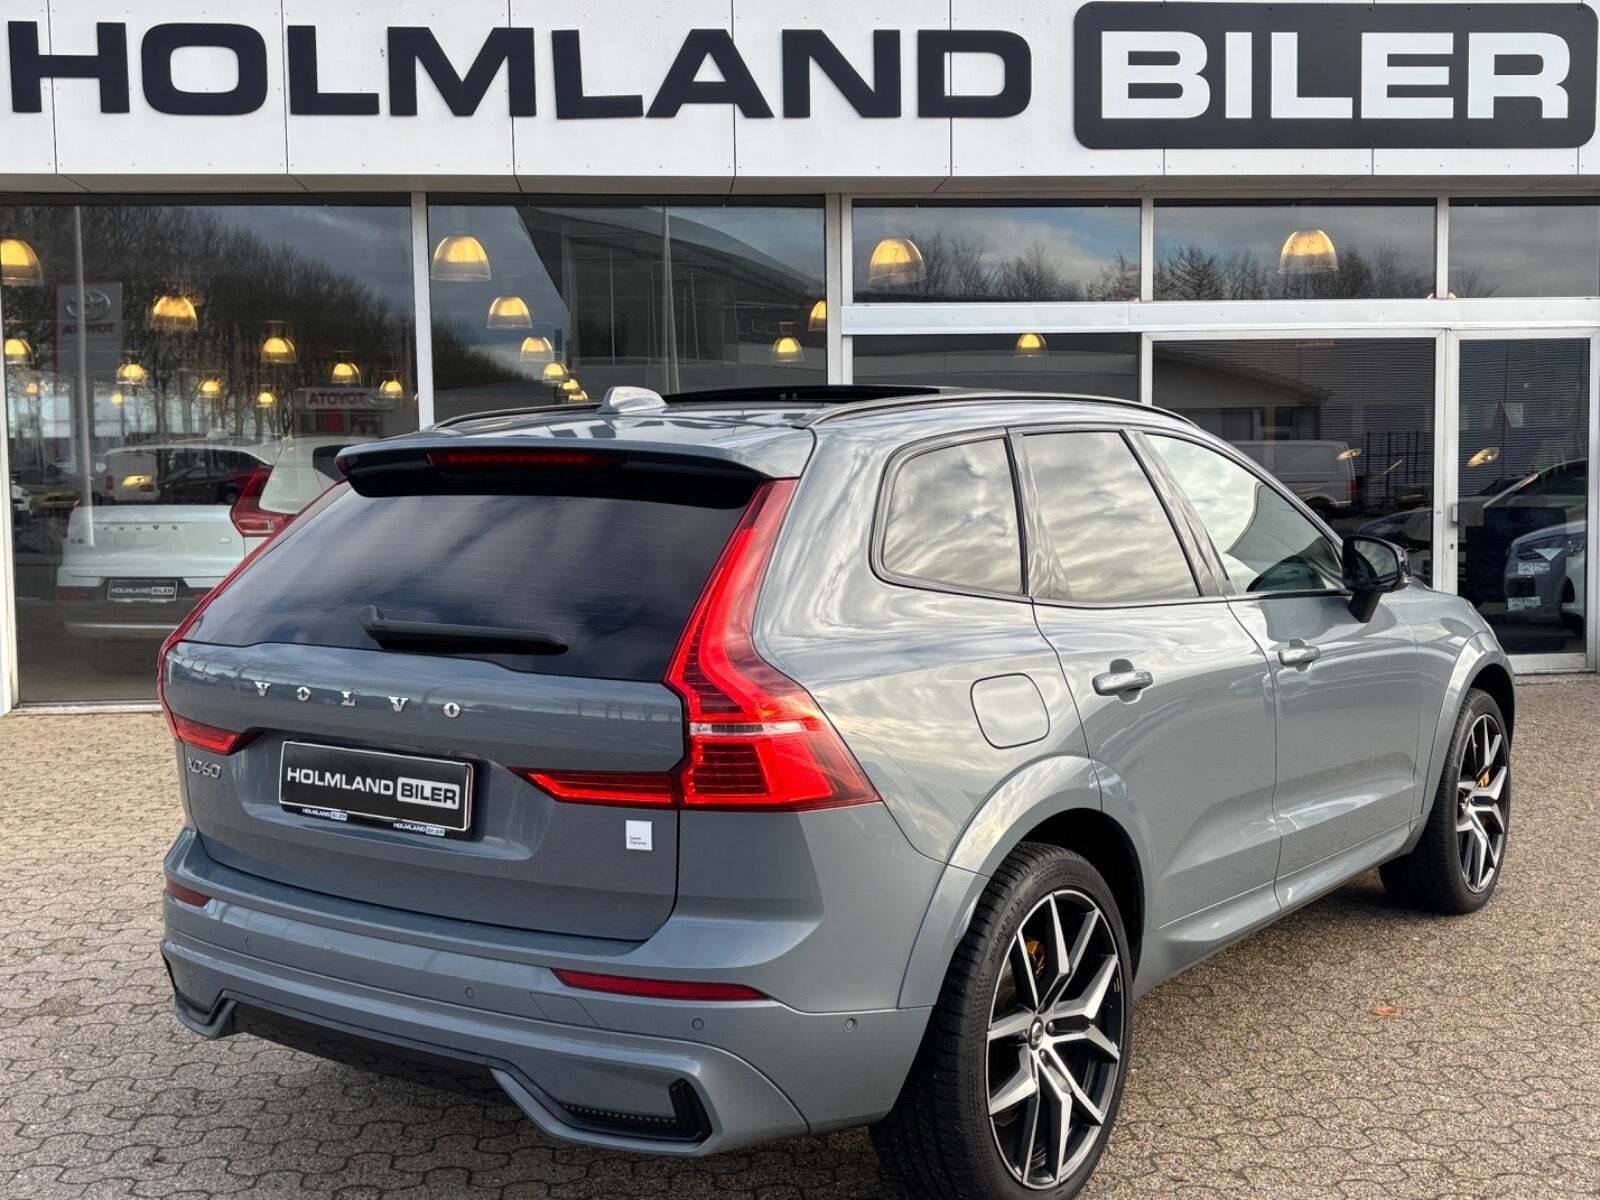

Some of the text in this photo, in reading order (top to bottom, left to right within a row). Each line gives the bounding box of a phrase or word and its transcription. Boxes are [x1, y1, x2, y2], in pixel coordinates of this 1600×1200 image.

[8, 21, 1571, 119] HOLMLAND BILER
[255, 681, 460, 718] VOLVO
[187, 756, 220, 778] XC60
[287, 767, 457, 805] HOLMLAND BILER
